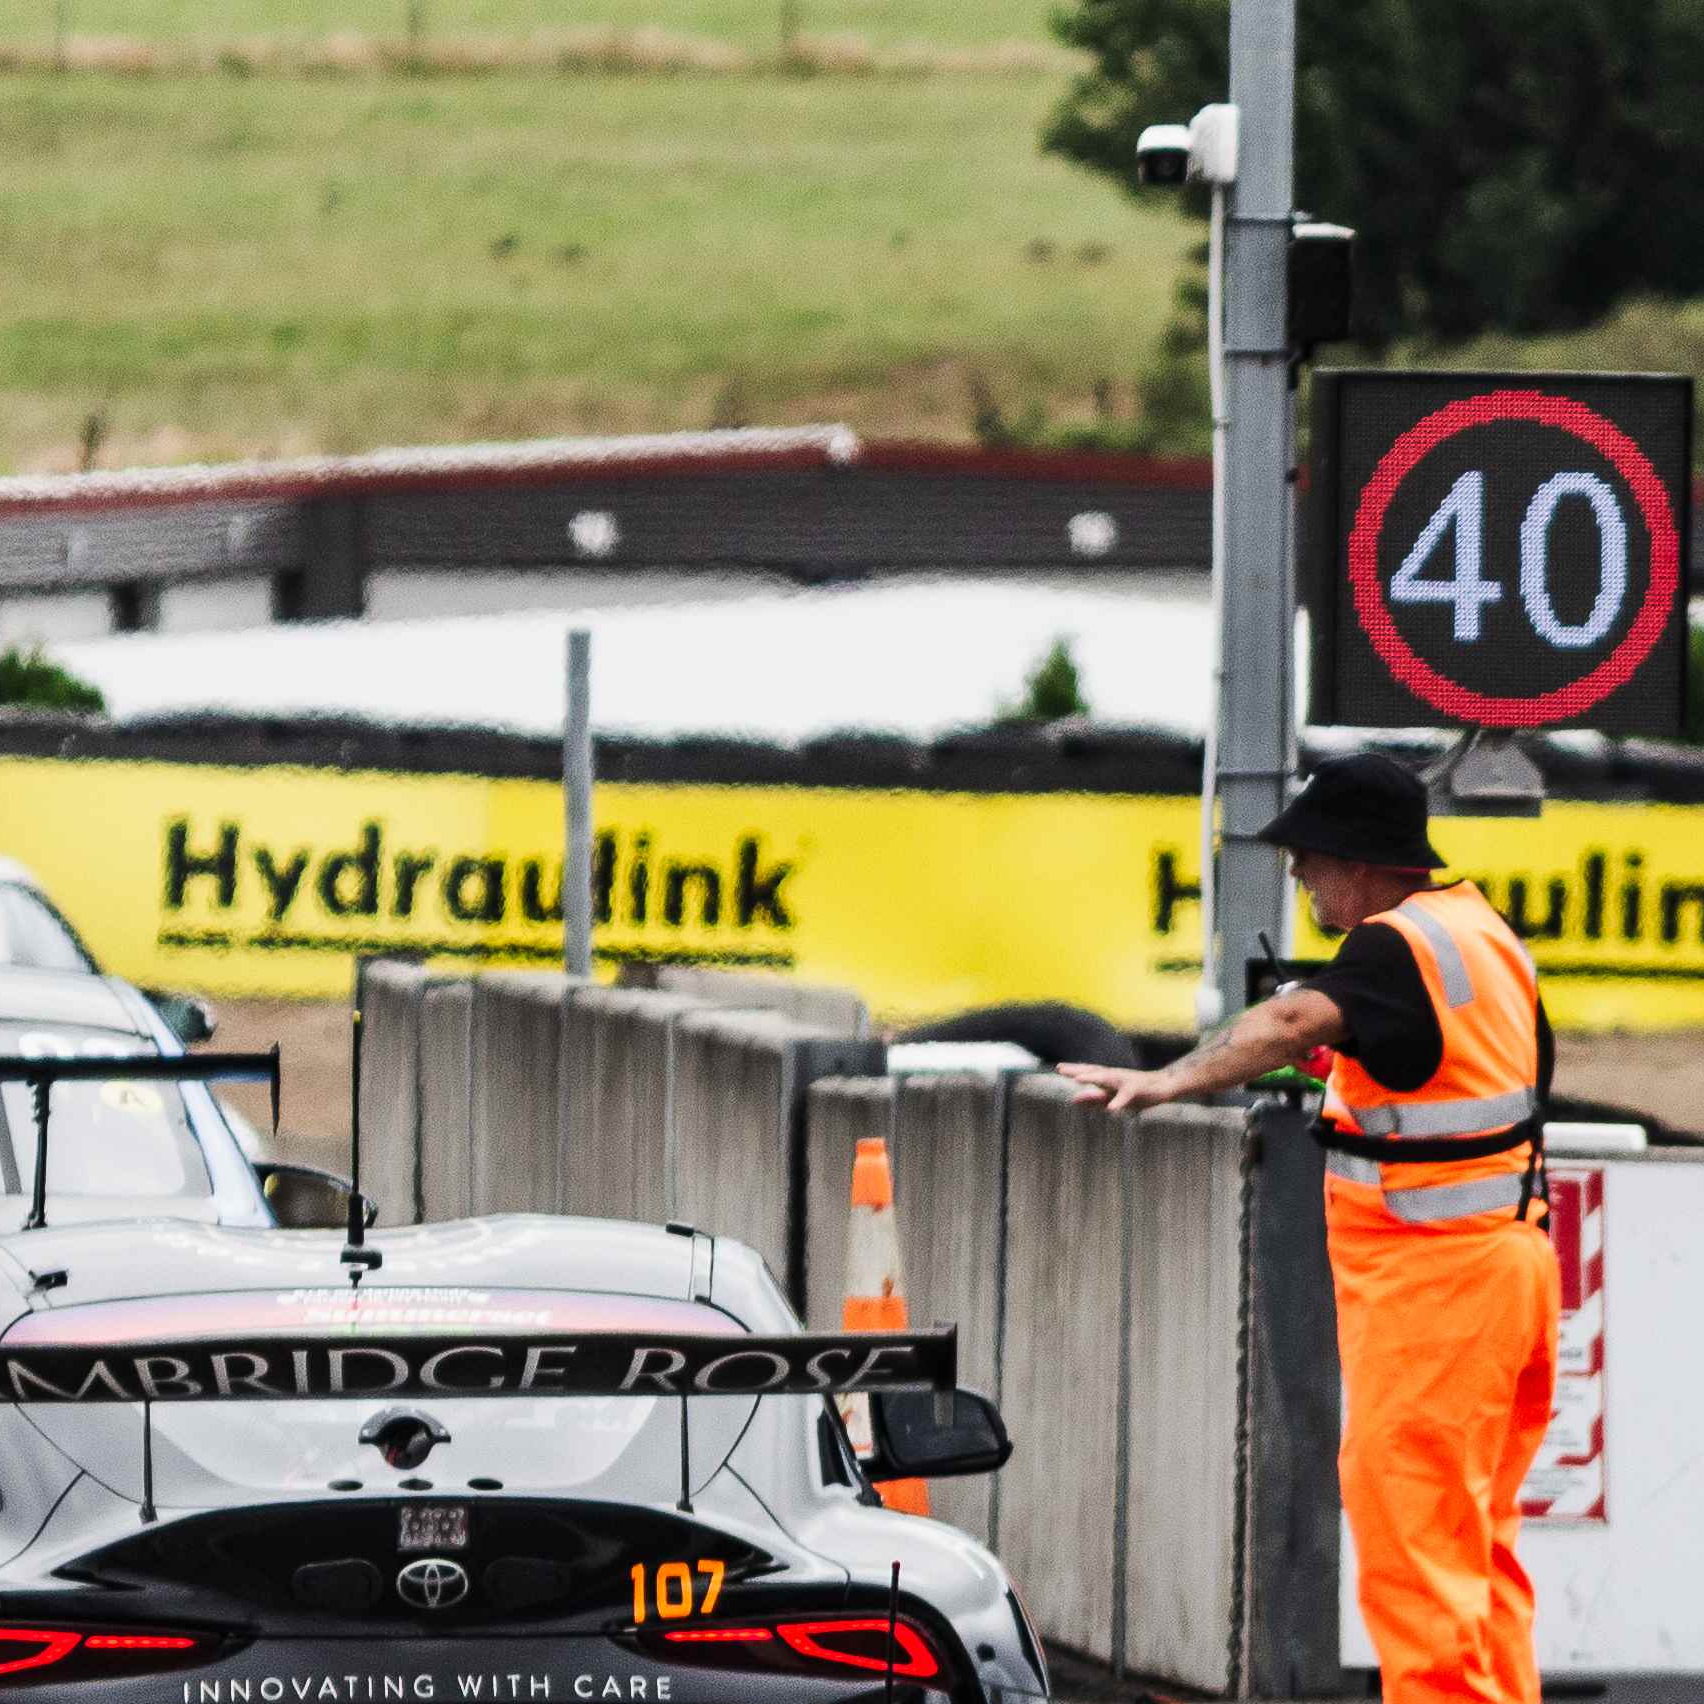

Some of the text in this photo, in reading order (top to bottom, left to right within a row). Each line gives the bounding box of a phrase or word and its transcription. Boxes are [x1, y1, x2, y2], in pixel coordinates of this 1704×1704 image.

[1389, 470, 1628, 649] 40
[163, 815, 798, 928] Hydraulink
[617, 1345, 915, 1395] ROSE
[631, 1559, 725, 1624] 107
[182, 1673, 673, 1704] INNOVATING WITH CARE
